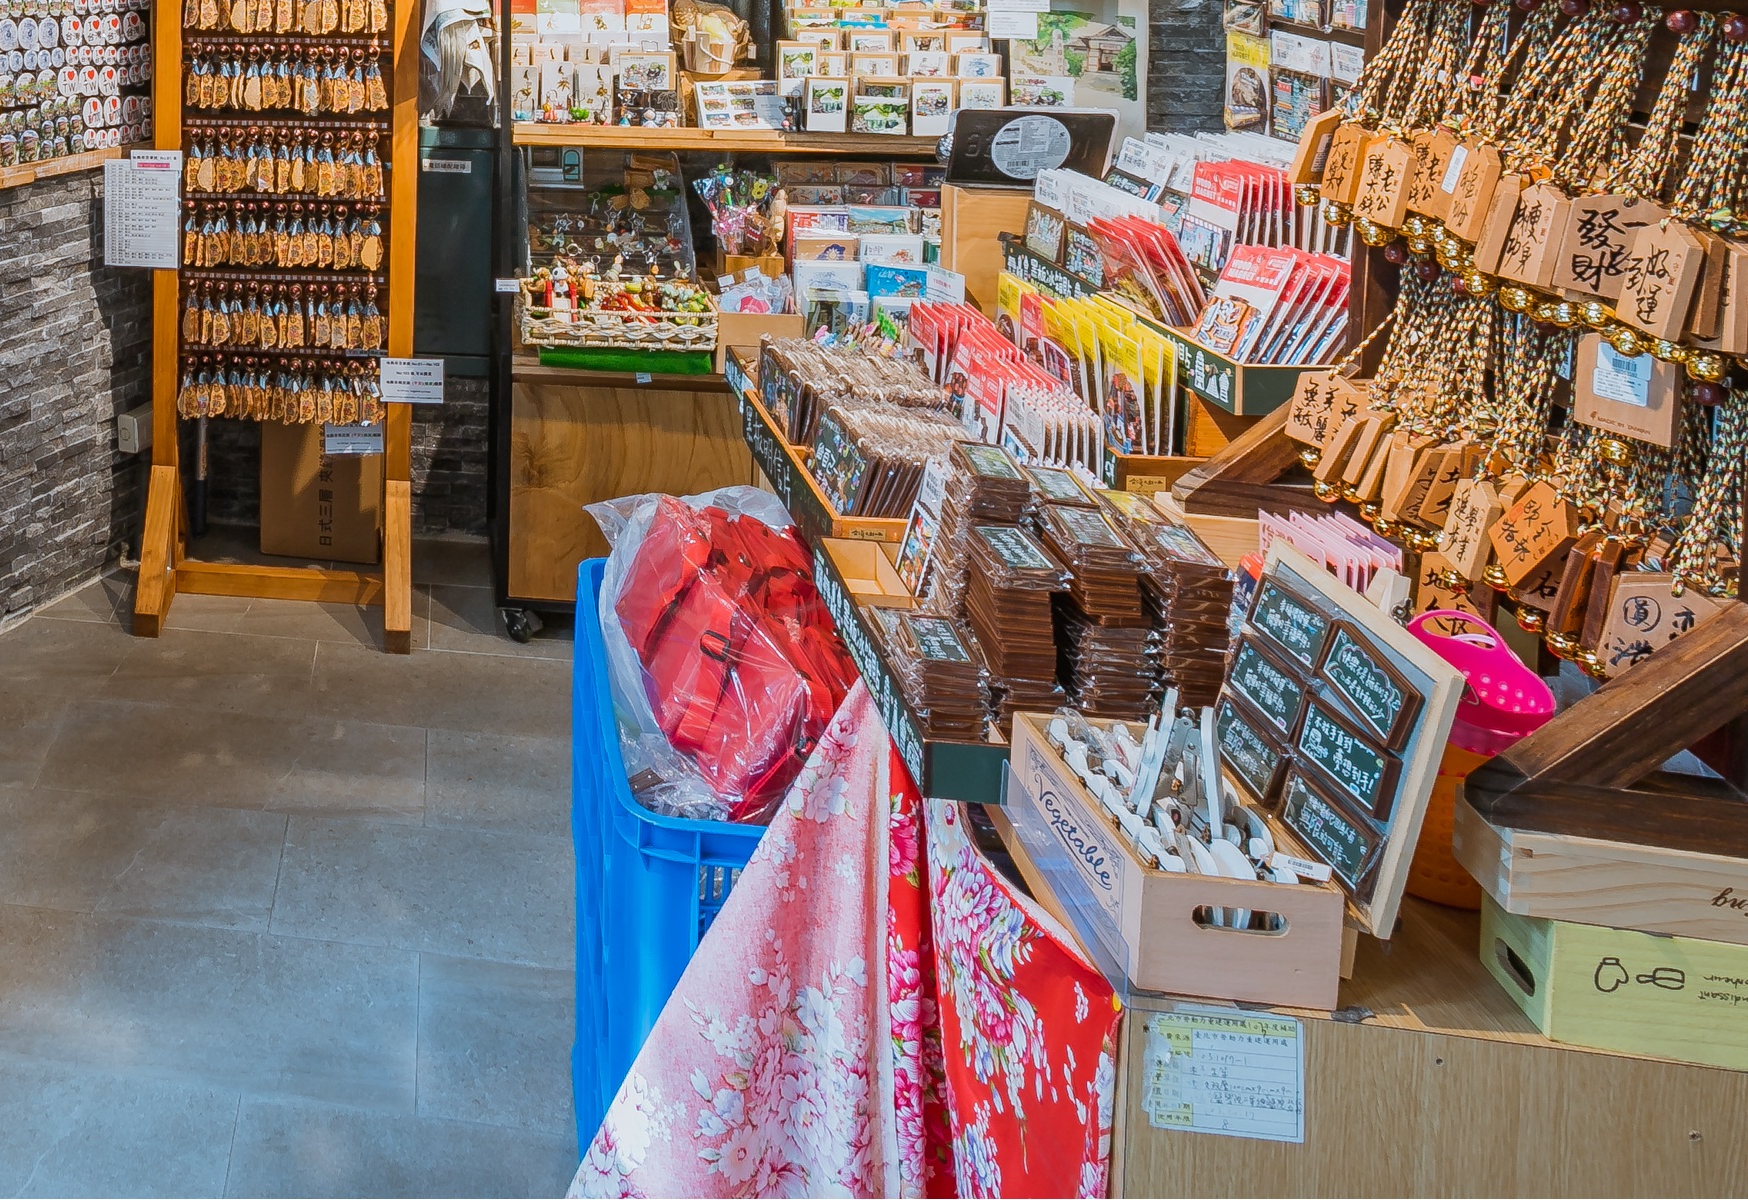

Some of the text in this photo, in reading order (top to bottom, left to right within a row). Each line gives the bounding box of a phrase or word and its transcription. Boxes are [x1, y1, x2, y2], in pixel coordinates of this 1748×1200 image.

[1597, 414, 1618, 425] MADE
[1315, 714, 1352, 754] 不放手直到
[1035, 773, 1112, 890] Vegetable
